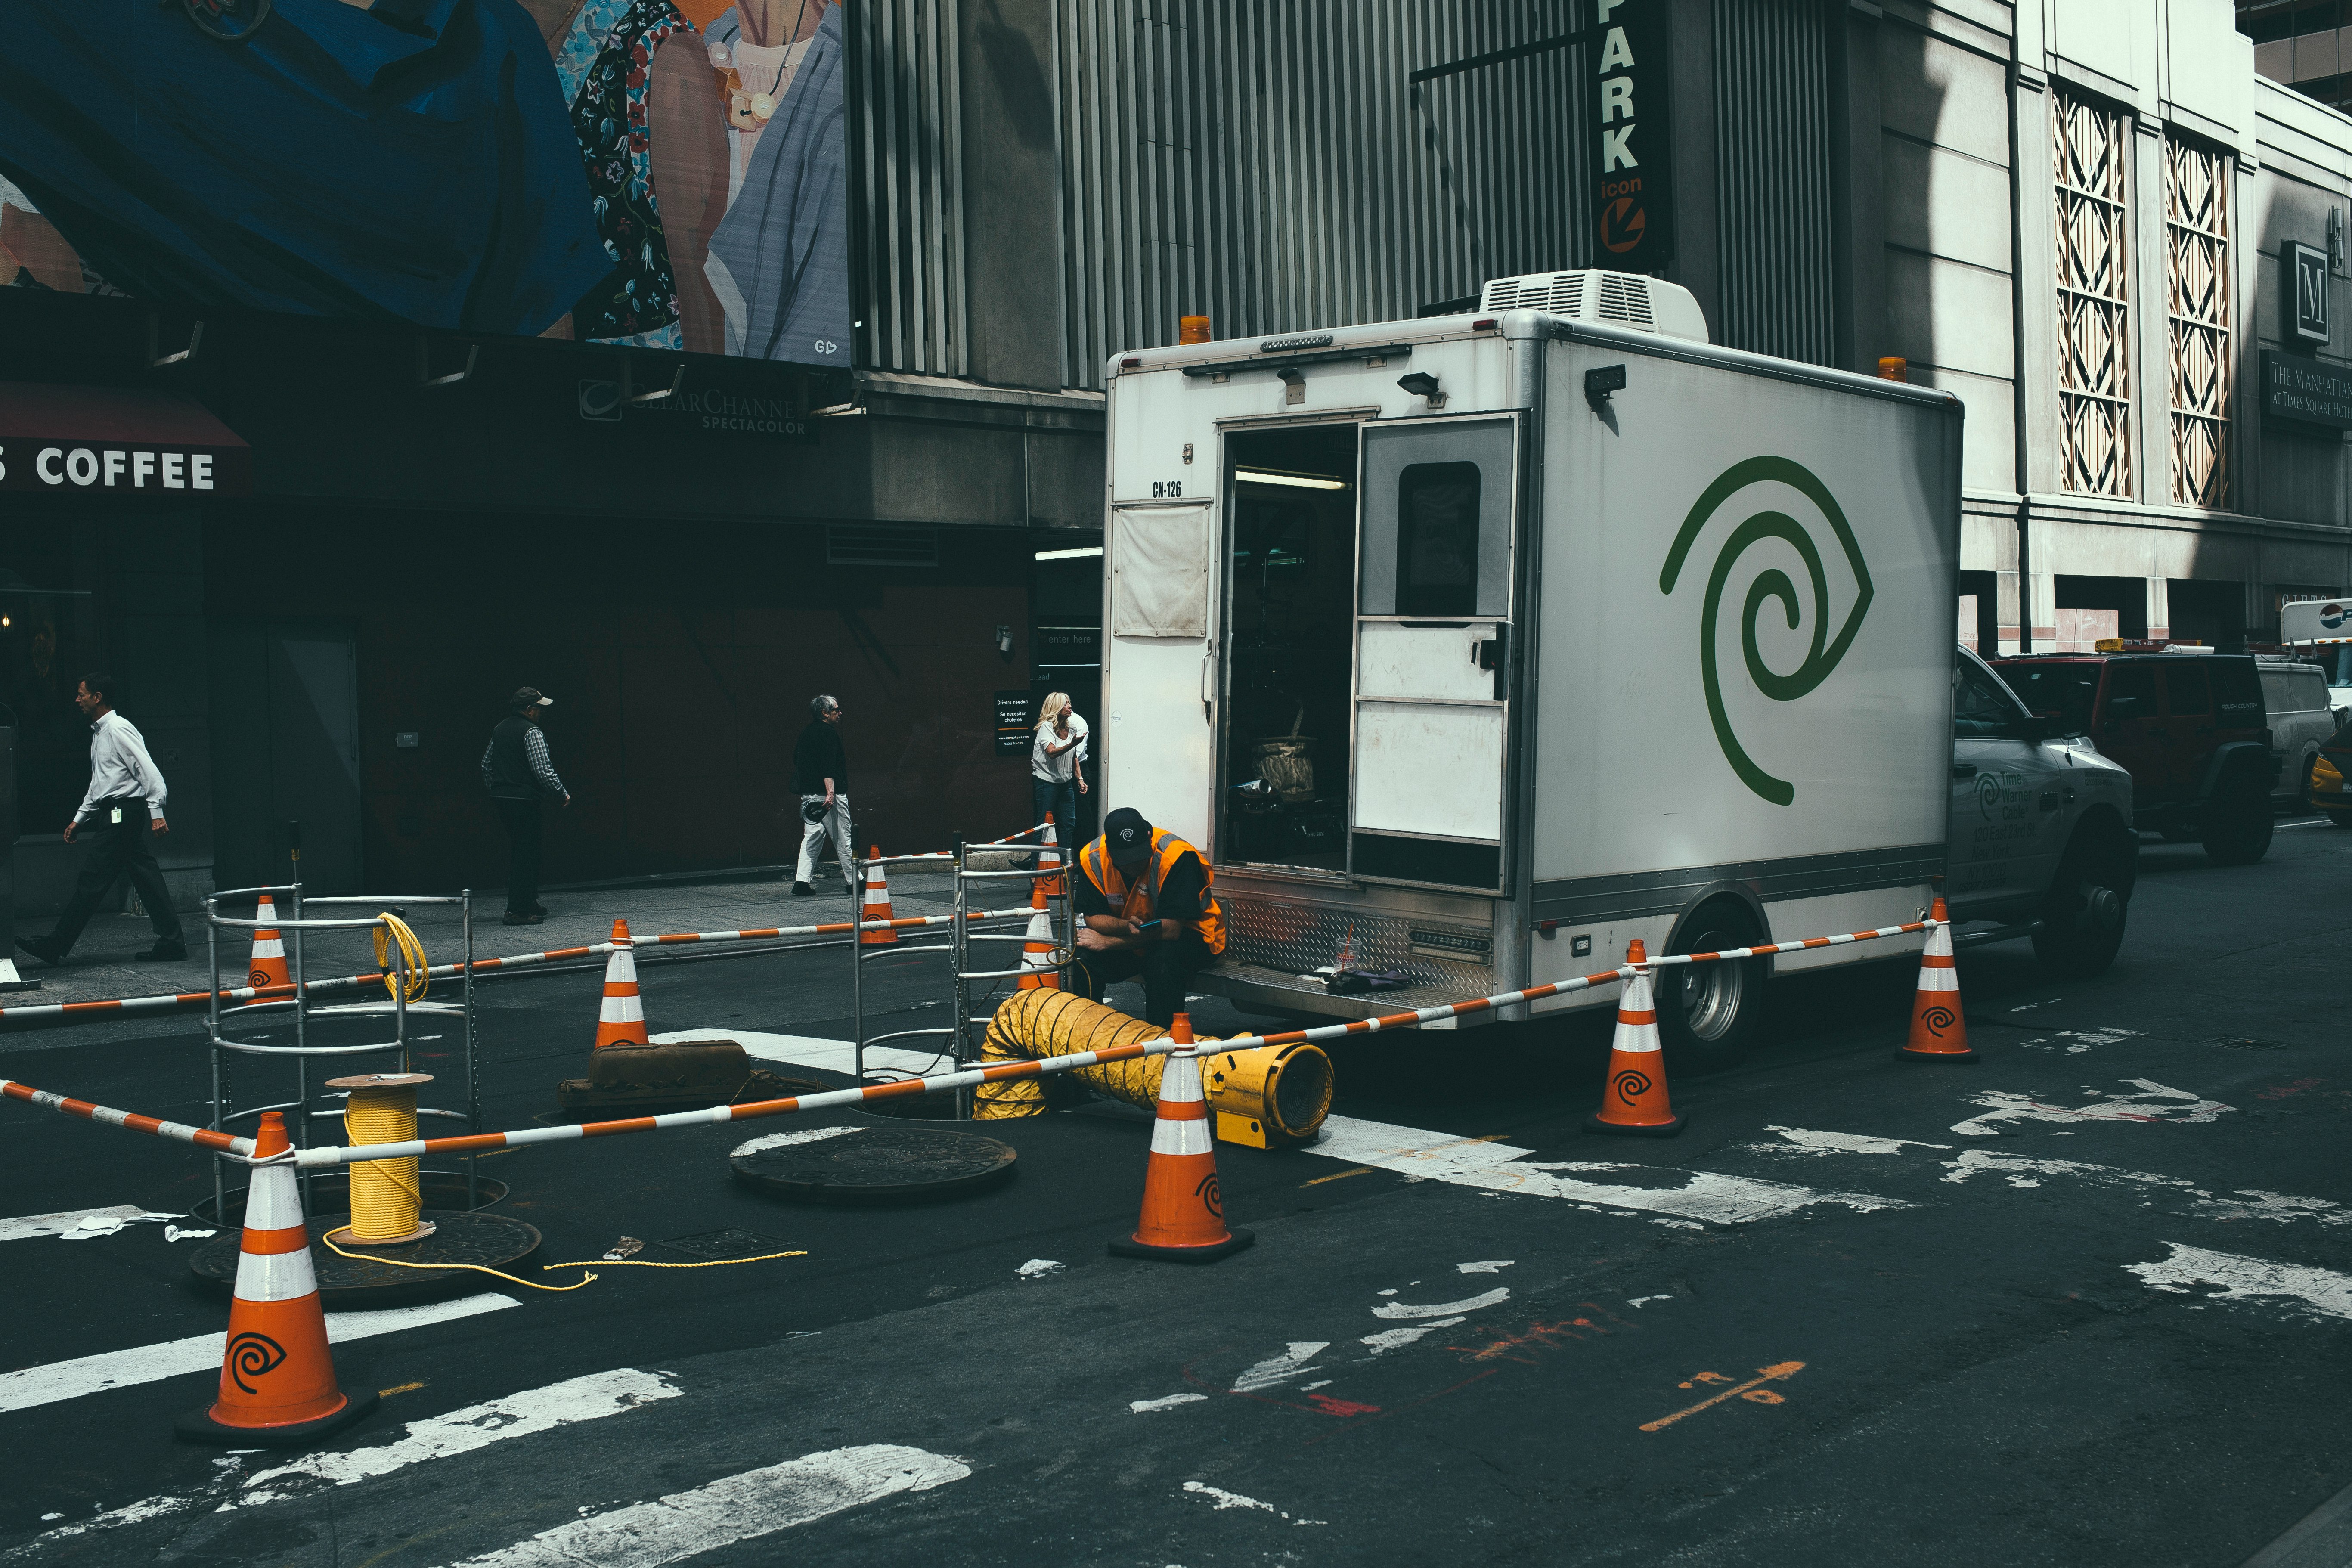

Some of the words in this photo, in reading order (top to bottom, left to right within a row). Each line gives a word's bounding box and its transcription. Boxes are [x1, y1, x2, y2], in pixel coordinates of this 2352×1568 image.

[1598, 0, 1639, 174] PARK
[1601, 177, 1642, 199] icon
[2301, 263, 2324, 324] M
[2271, 361, 2292, 387] THE
[2282, 390, 2304, 410] TIMES
[2306, 396, 2331, 416] SQUARE
[702, 415, 805, 435] SPECTACOLOR
[36, 447, 214, 490] COFFEE
[1153, 480, 1181, 498] CN-126
[1048, 635, 1070, 644] enter
[1073, 634, 1091, 644] here
[2000, 771, 2022, 786] Time
[2002, 788, 2032, 803] Warner
[1974, 826, 1988, 843] 120
[1989, 825, 2007, 841] East
[2008, 823, 2026, 839] 23rd
[2027, 822, 2036, 837] St.
[1971, 846, 1990, 861] New
[1967, 865, 1981, 880] NY
[1982, 862, 2007, 880] 10010
